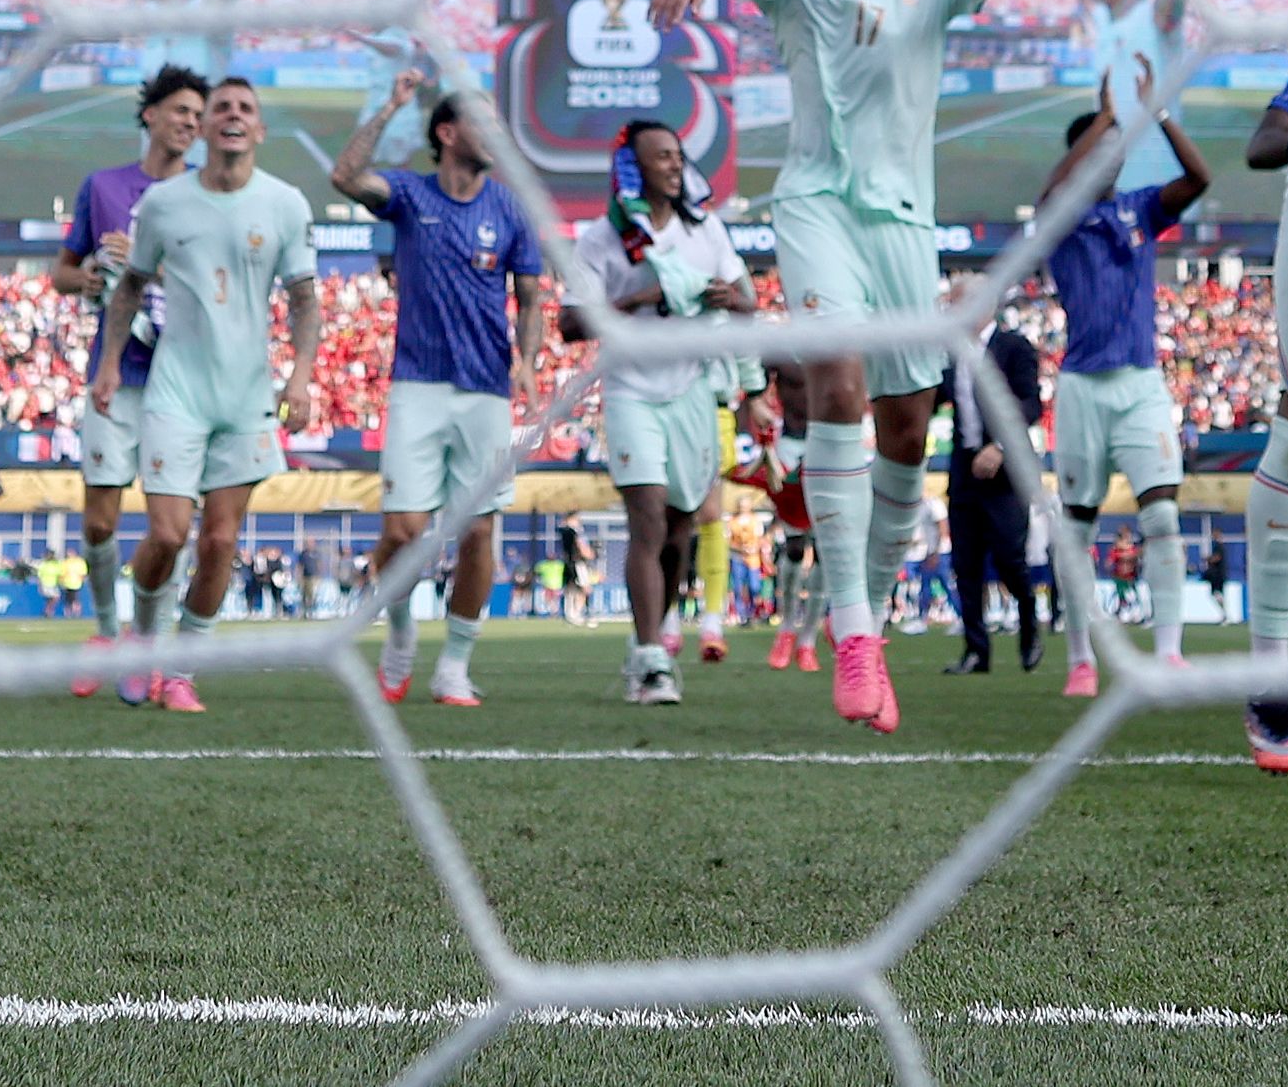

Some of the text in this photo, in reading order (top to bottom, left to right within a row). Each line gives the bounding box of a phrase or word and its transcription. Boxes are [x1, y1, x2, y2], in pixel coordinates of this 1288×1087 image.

[854, 1, 885, 47] 17
[596, 38, 634, 51] FIFA
[567, 68, 661, 83] WORLD CUP
[567, 83, 662, 109] 2026
